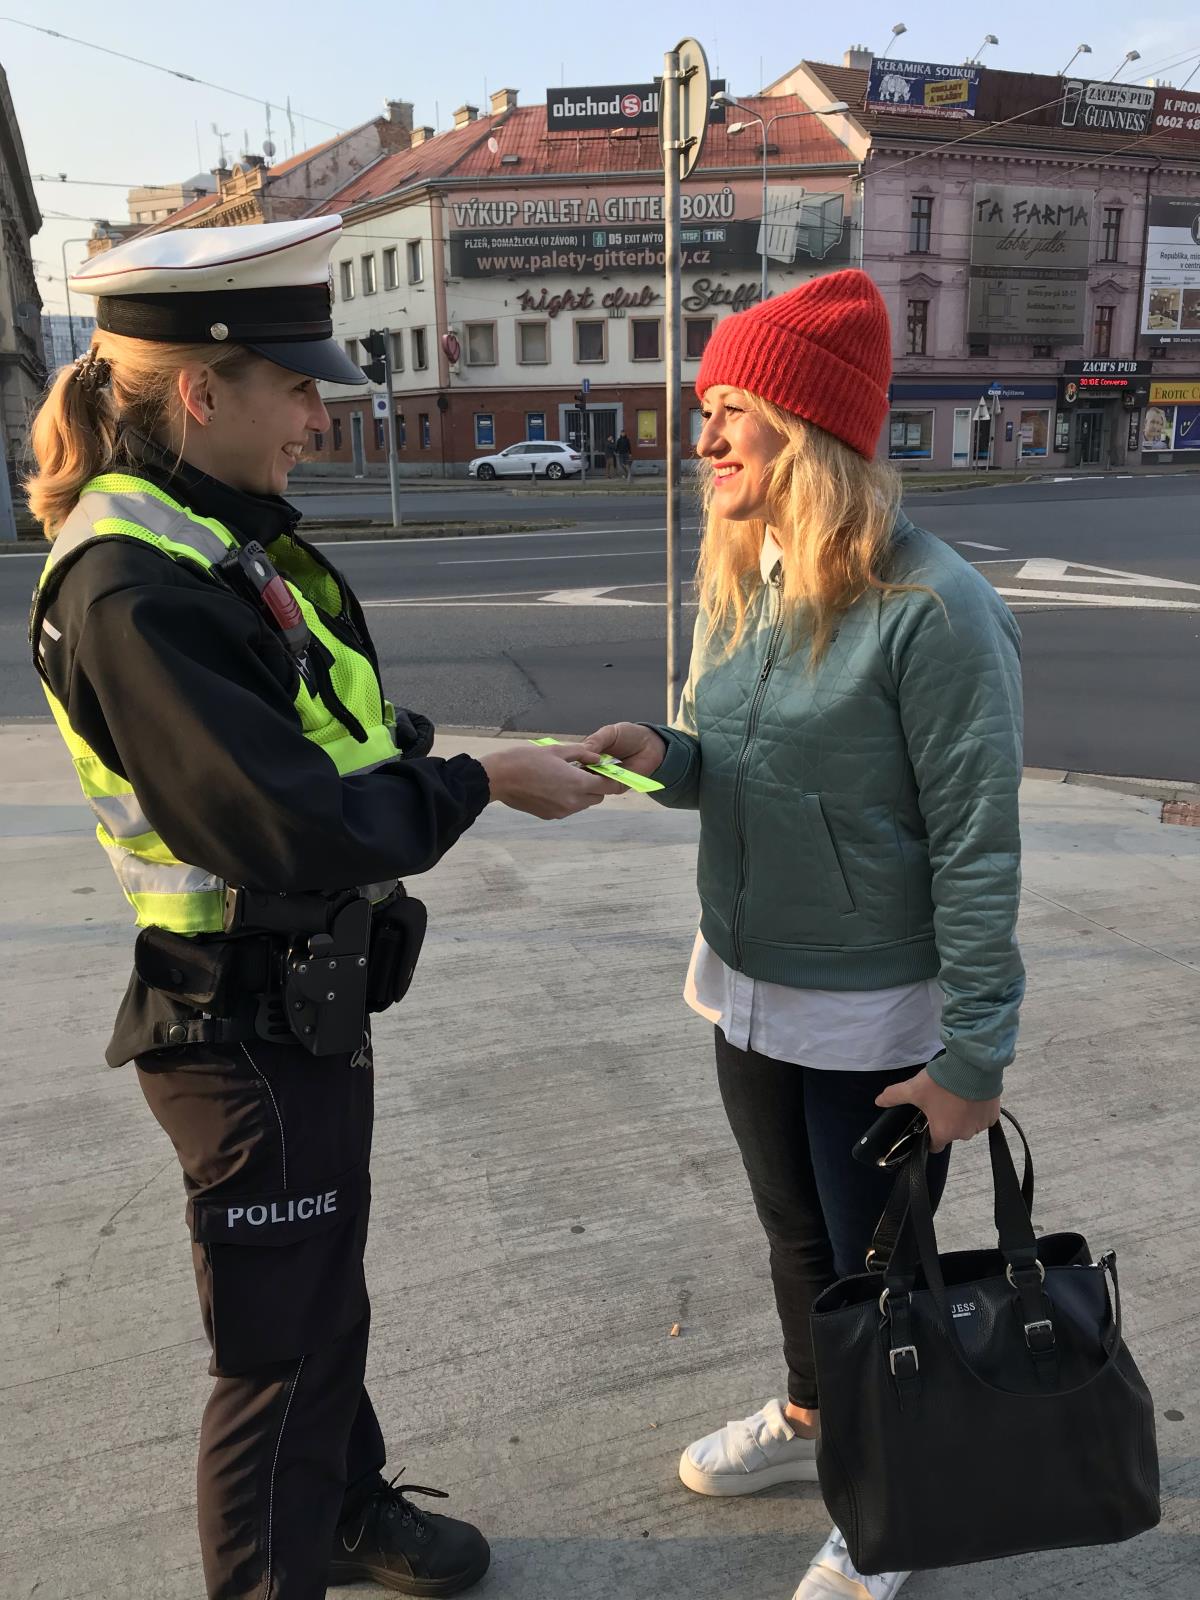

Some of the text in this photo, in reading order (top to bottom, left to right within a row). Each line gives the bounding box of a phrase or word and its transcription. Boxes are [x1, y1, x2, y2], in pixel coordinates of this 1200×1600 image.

[876, 60, 932, 75] KERAMIKA
[1088, 87, 1152, 106] ZACH'S PUB
[1163, 99, 1173, 111] K
[1085, 105, 1146, 131] GUINNESS
[1156, 115, 1185, 129] 0602
[453, 198, 518, 226] VÝKUP
[522, 199, 582, 224] PALET
[586, 198, 600, 222] A
[976, 198, 1089, 227] TA FARMA
[491, 235, 539, 248] DOMAŽLICKÁ
[624, 233, 641, 244] EXIT
[642, 231, 664, 243] MÝTO
[704, 231, 724, 241] TIR
[477, 248, 711, 273] www.palety-gitterboy.cz
[601, 285, 661, 308] club
[1082, 362, 1137, 372] ZACH'S PUB
[227, 1189, 338, 1228] POLICIE
